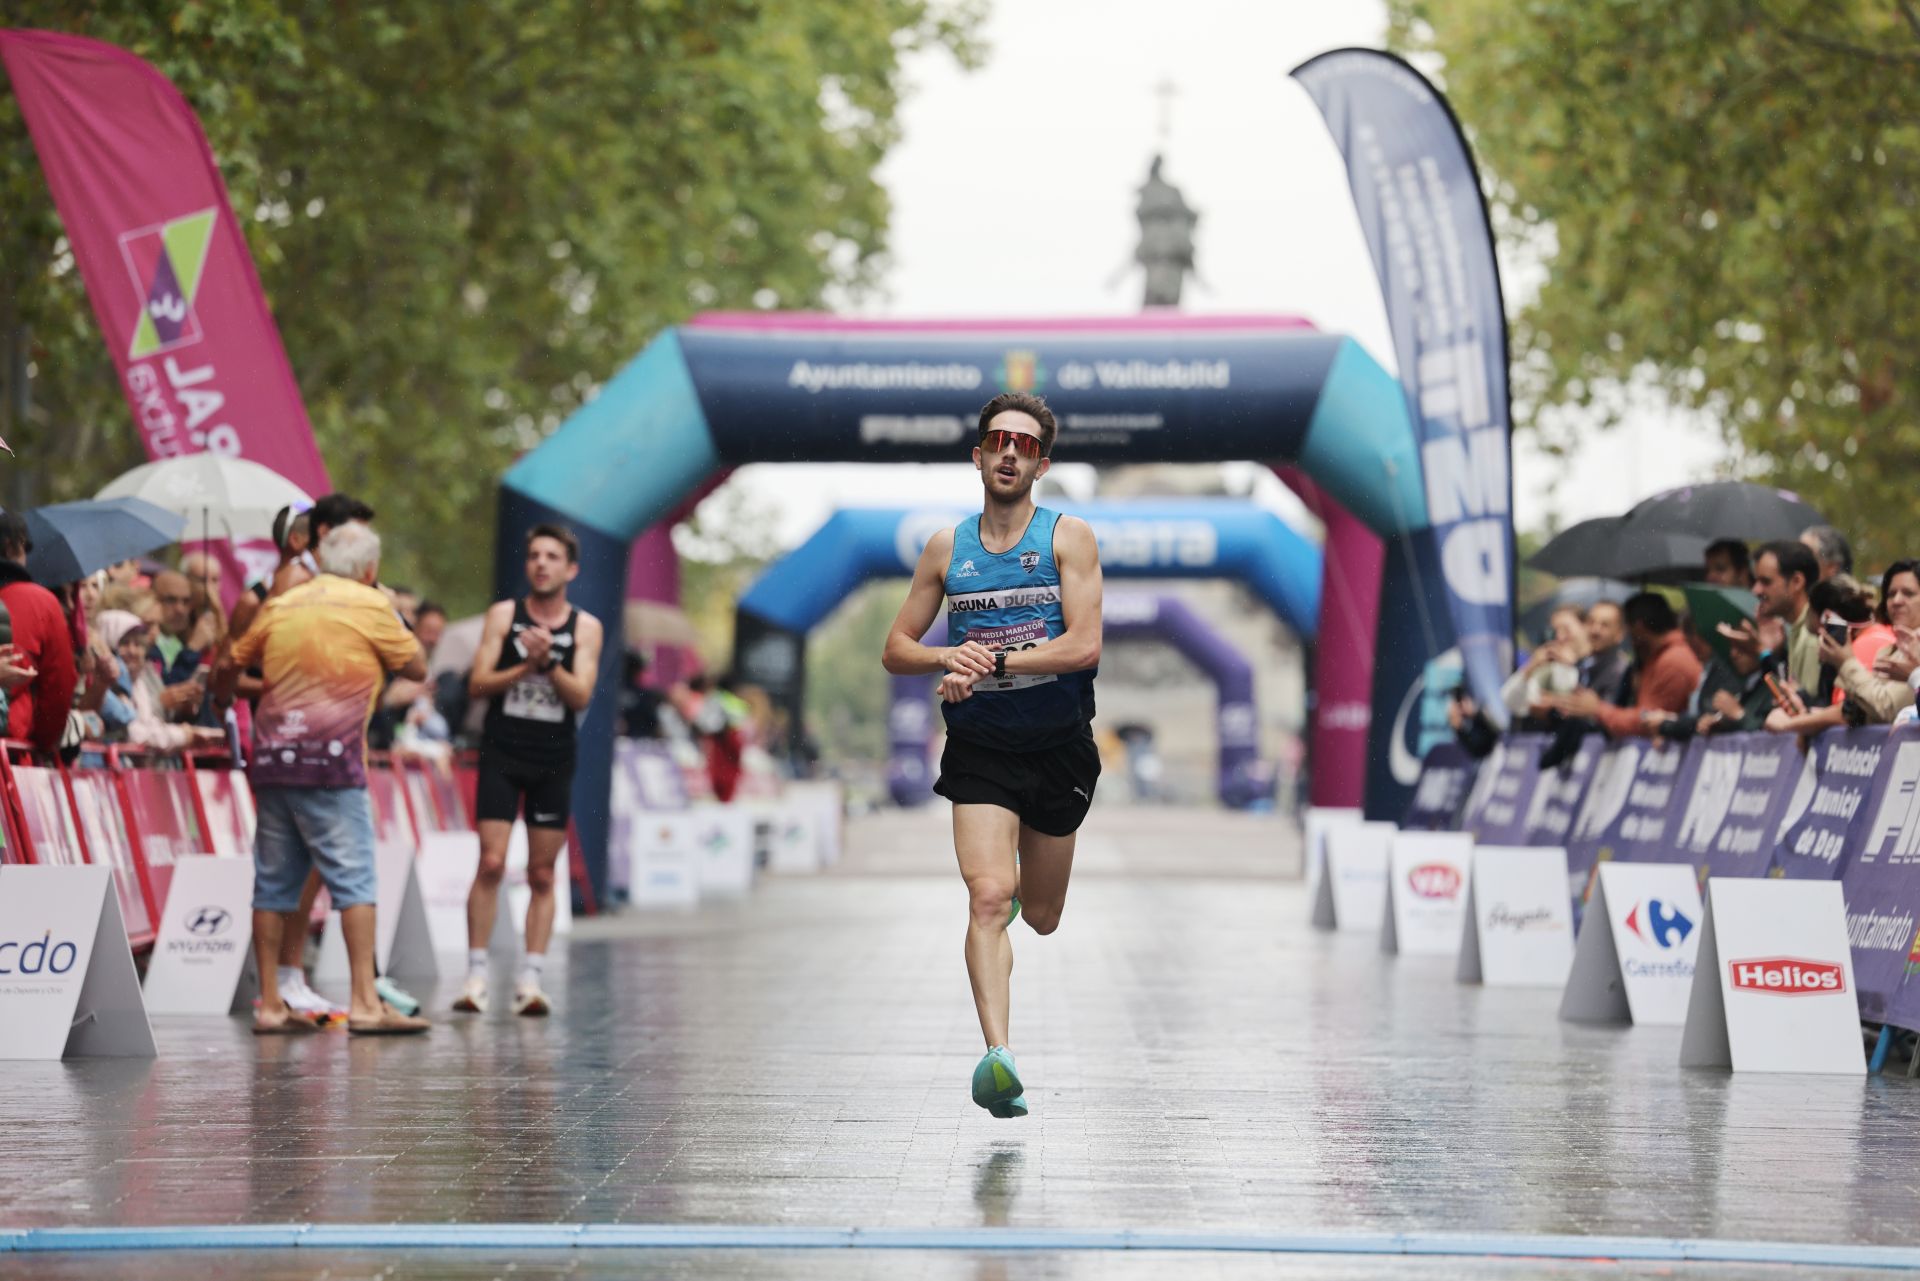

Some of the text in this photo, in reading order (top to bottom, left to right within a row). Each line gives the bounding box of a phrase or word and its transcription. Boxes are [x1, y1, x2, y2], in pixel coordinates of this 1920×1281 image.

[789, 359, 1230, 392] Ayuntamiento de Valladolid
[980, 630, 1005, 639] MEDIA
[1005, 621, 1044, 636] MARATÓN
[1825, 744, 1882, 777] Fundació
[1794, 826, 1846, 865] de Dep
[1738, 965, 1839, 989] Helios
